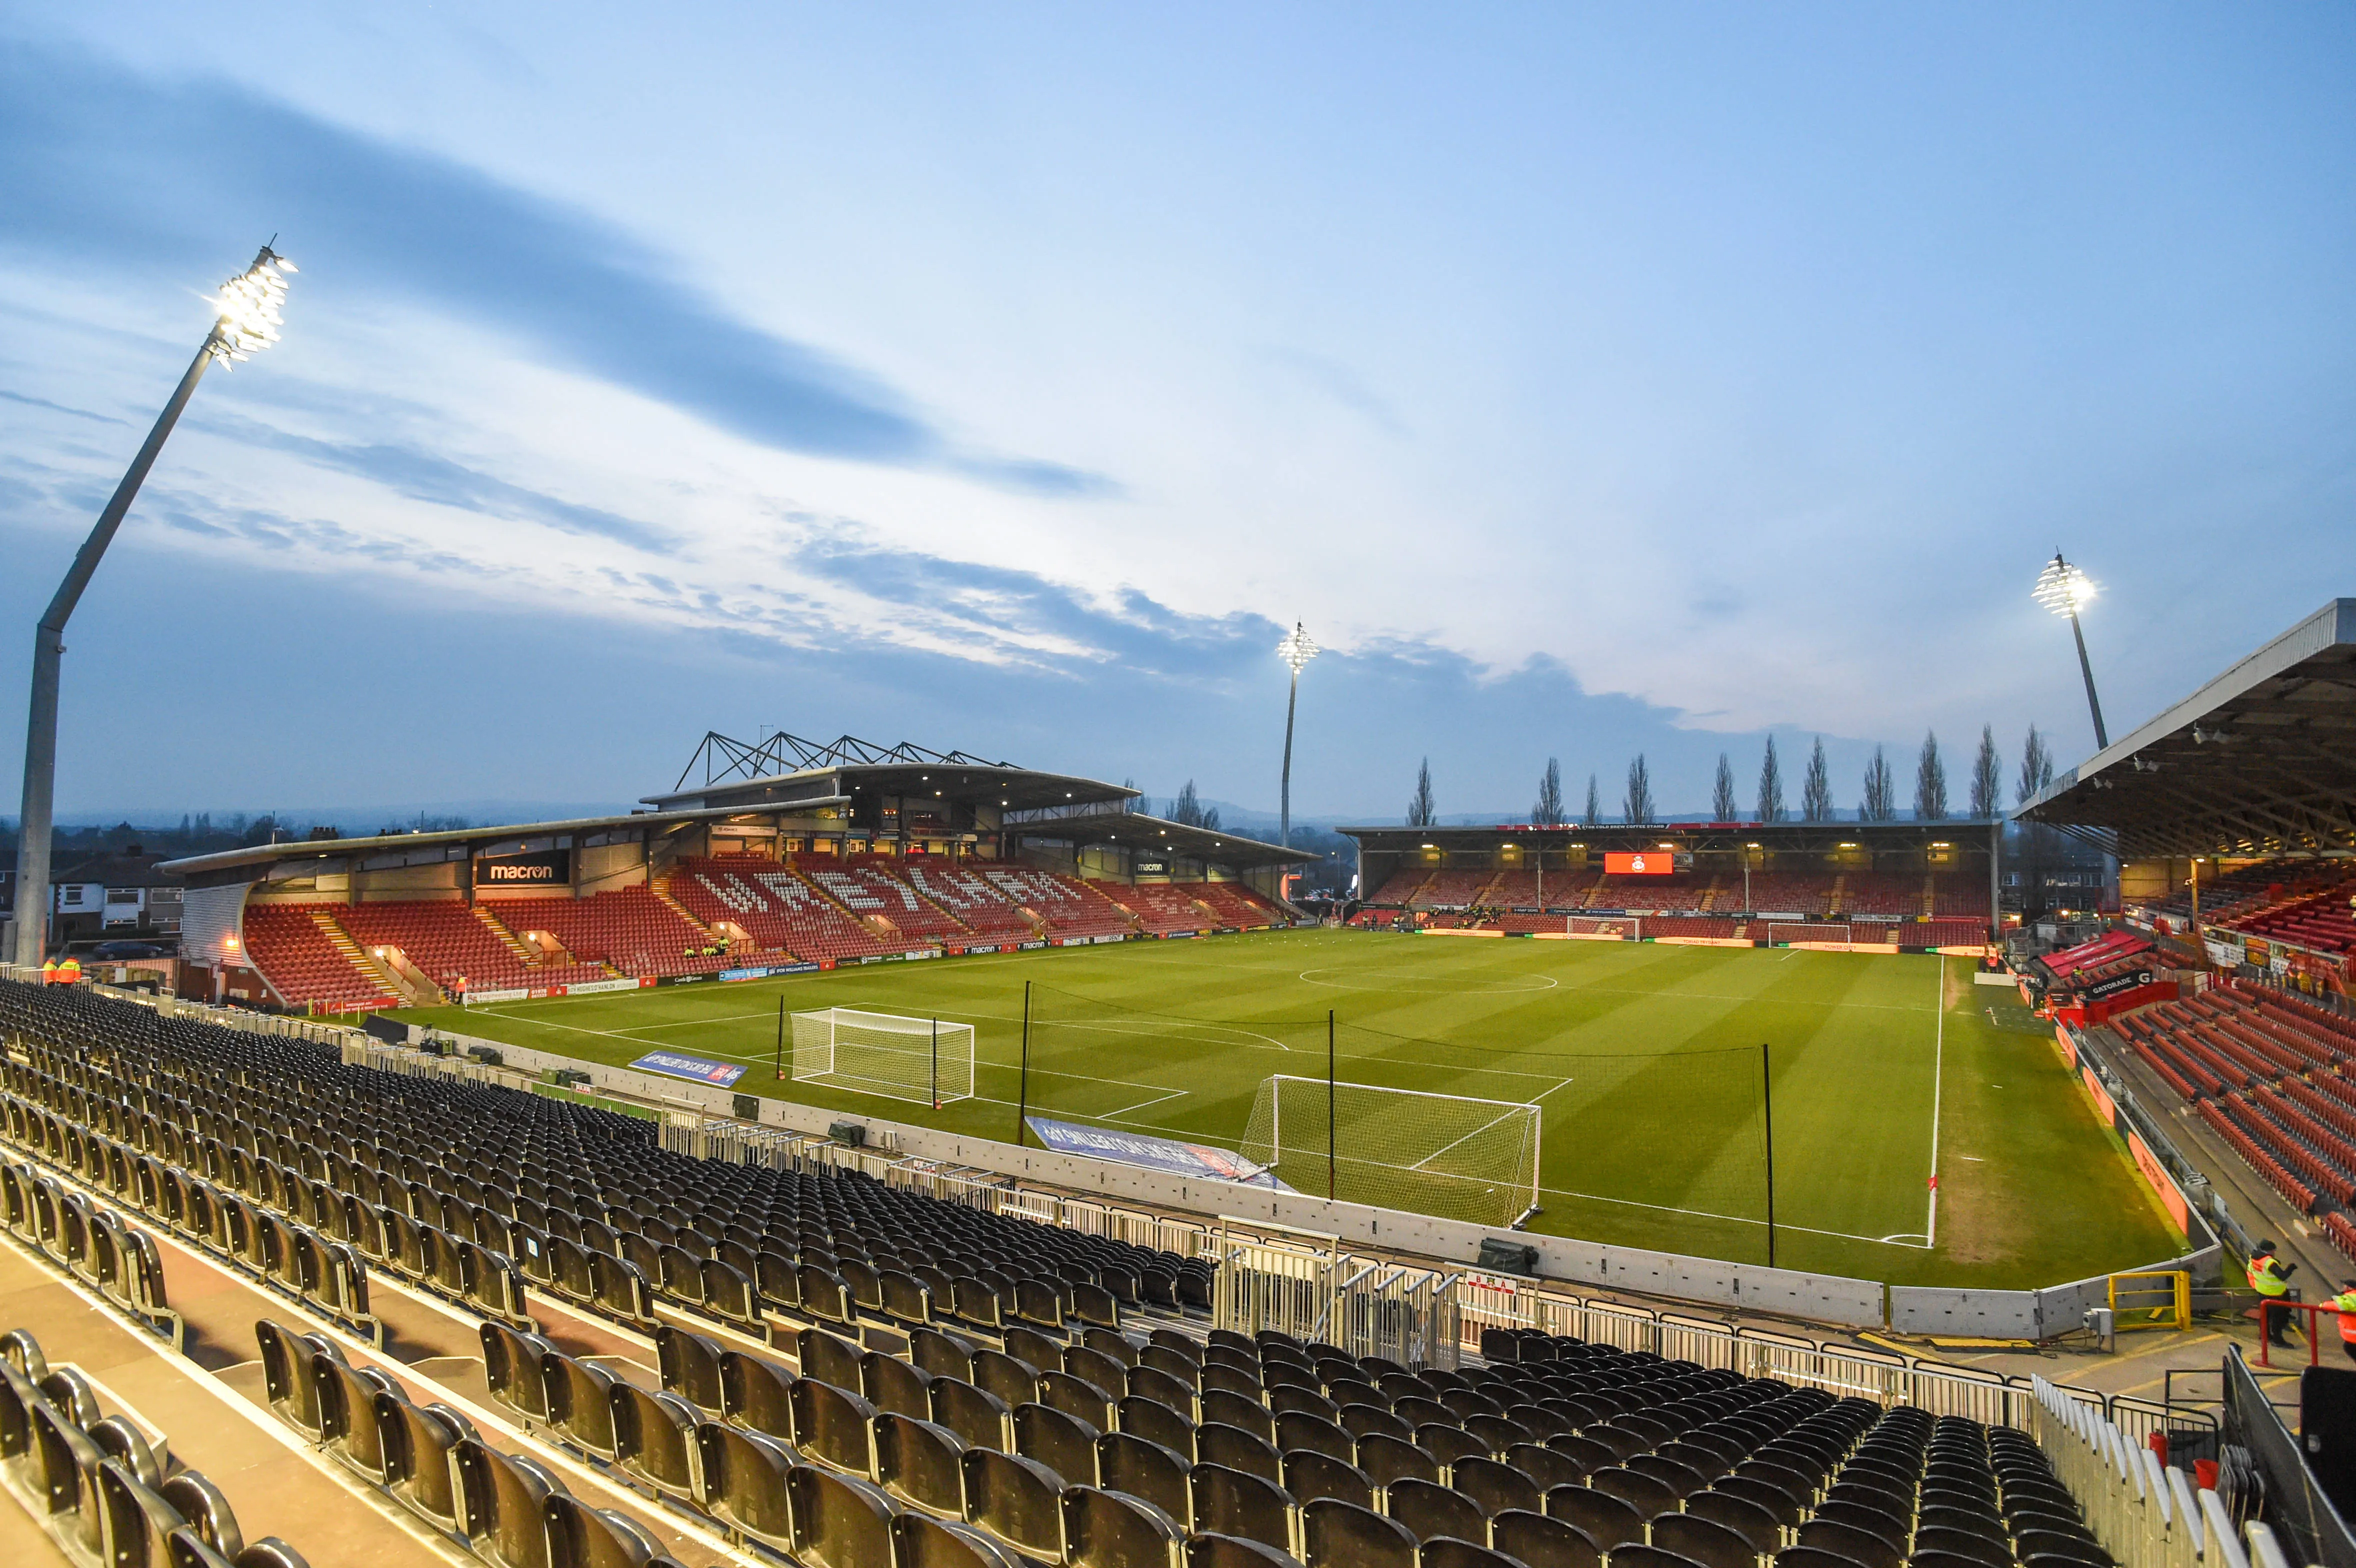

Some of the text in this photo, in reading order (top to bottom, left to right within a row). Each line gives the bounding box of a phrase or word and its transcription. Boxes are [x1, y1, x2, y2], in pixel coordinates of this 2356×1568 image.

[491, 866, 552, 879] macron
[1138, 864, 1162, 872] macron
[694, 866, 1082, 912] WREXHAM
[972, 946, 995, 954] macron
[1023, 941, 1044, 950] macron
[2092, 977, 2132, 994] GATORADE
[2138, 973, 2150, 984] G
[724, 1067, 741, 1082] sky
[1042, 1124, 1067, 1143] APP
[1064, 1128, 1115, 1150] BETTING
